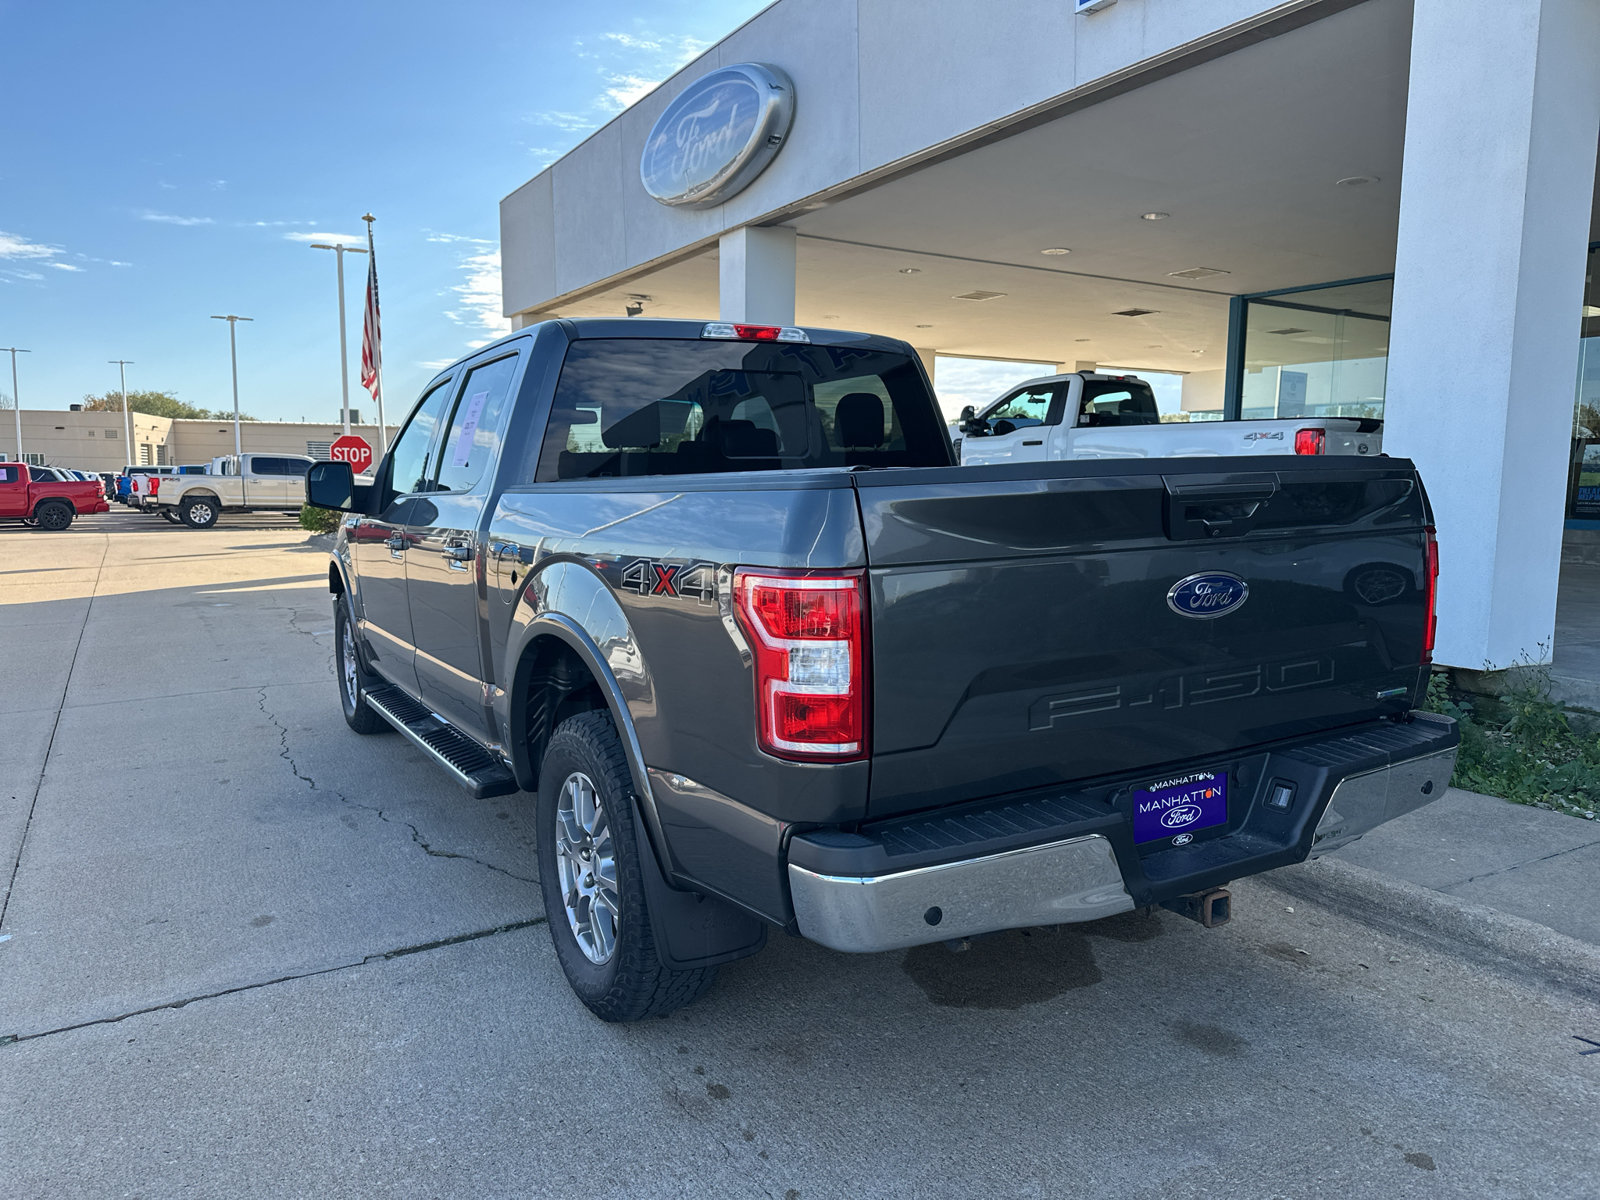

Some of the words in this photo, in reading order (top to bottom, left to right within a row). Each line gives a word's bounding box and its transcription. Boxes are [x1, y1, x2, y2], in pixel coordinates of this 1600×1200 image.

[671, 98, 739, 180] Ford
[333, 447, 370, 462] STOP
[1190, 581, 1233, 608] Ford
[1028, 655, 1335, 732] F-150
[1154, 772, 1211, 789] MANHATTN
[1139, 786, 1221, 813] MANHATTN
[1167, 807, 1194, 825] Ford
